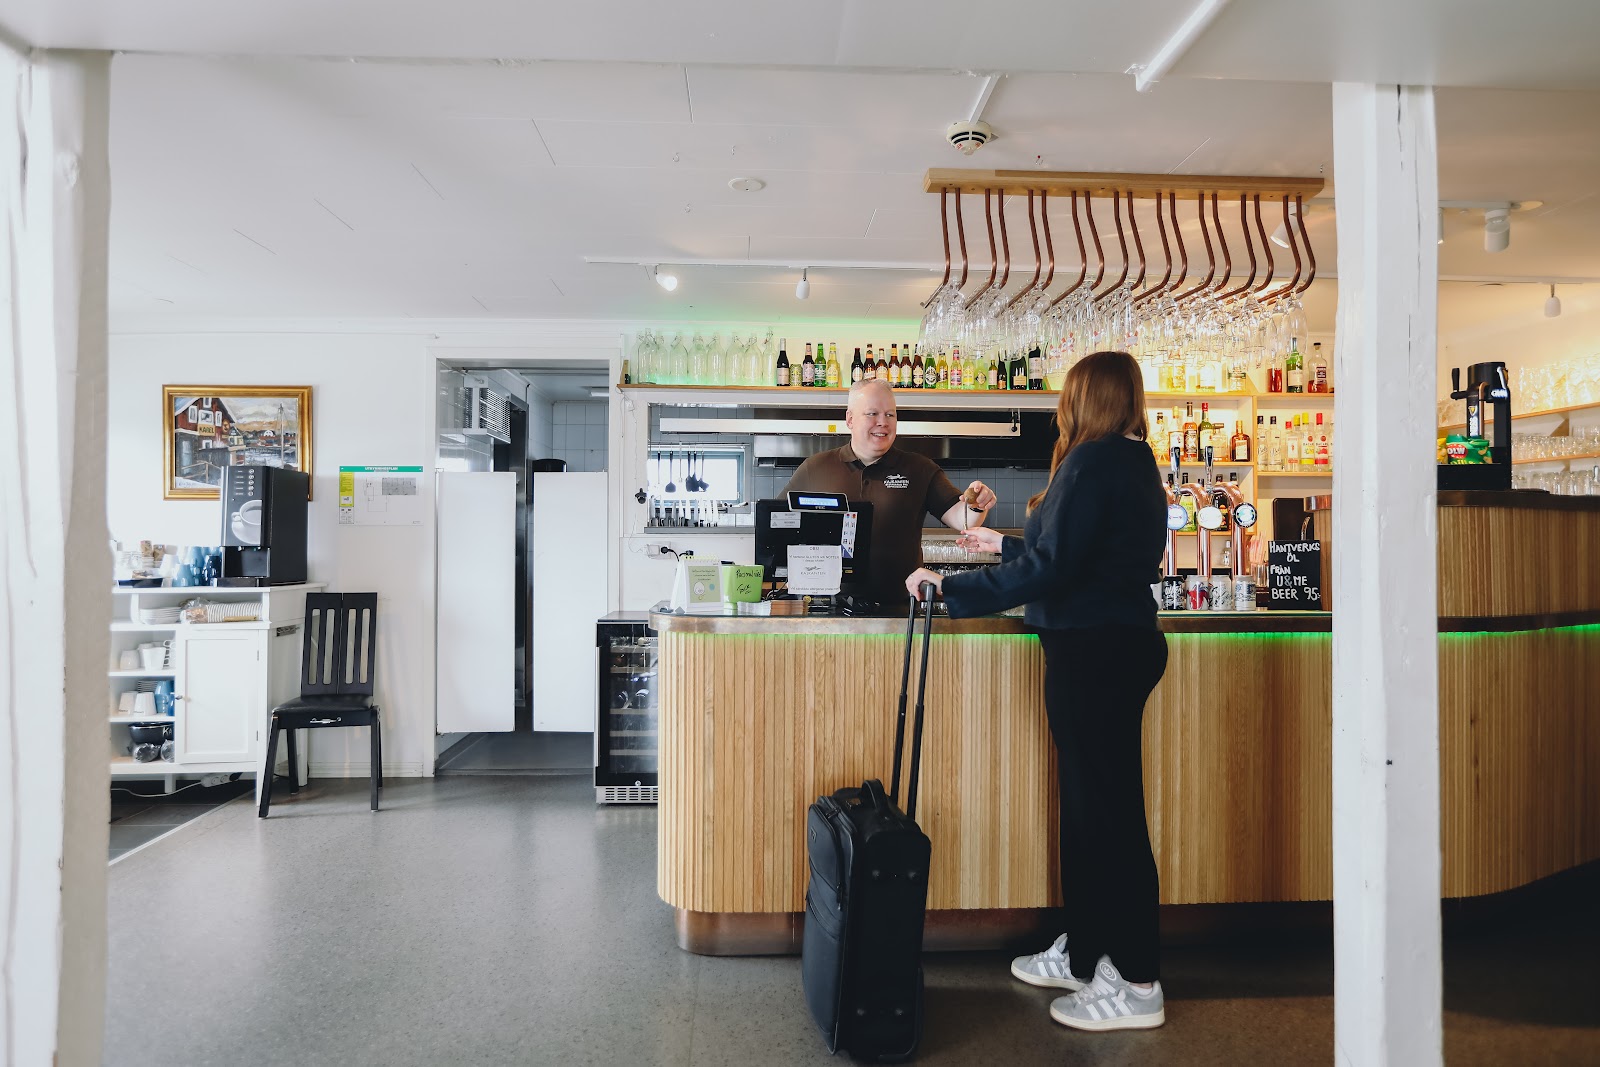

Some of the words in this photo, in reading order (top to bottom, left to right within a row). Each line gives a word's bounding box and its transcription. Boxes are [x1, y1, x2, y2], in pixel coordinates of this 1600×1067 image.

[1269, 541, 1320, 553] HANTVERKS
[1286, 552, 1300, 562] ÖL
[1270, 564, 1291, 575] FRÅN
[1271, 587, 1299, 601] BEER
